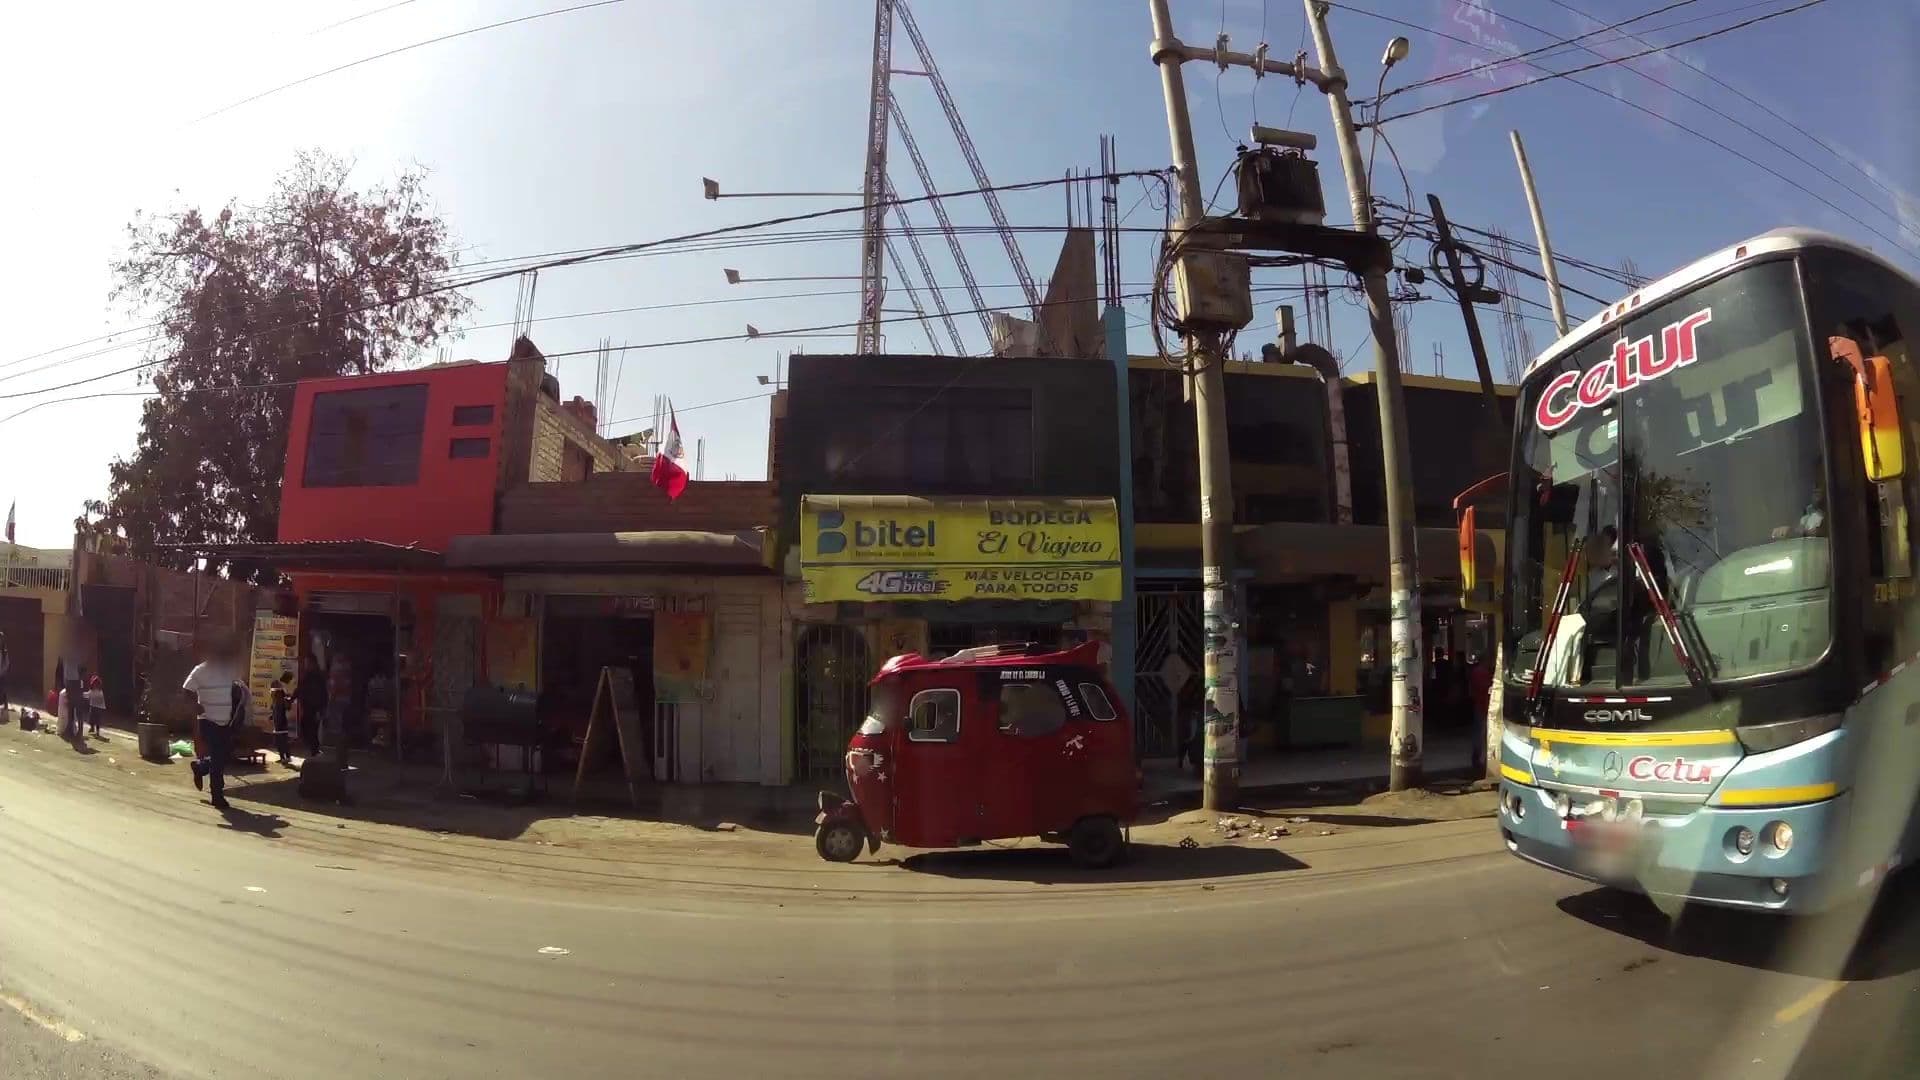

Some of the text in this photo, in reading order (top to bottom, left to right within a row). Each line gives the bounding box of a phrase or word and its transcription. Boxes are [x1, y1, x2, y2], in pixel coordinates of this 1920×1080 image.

[1536, 307, 1712, 432] Cetur
[990, 510, 1092, 526] BODEGA
[855, 520, 935, 547] bitel
[977, 530, 1102, 558] El Viajero
[857, 571, 936, 593] 4G bitel
[1003, 571, 1093, 581] VELOCIDAD
[975, 583, 1079, 593] PARA TODOS
[1584, 708, 1652, 722] COMIL
